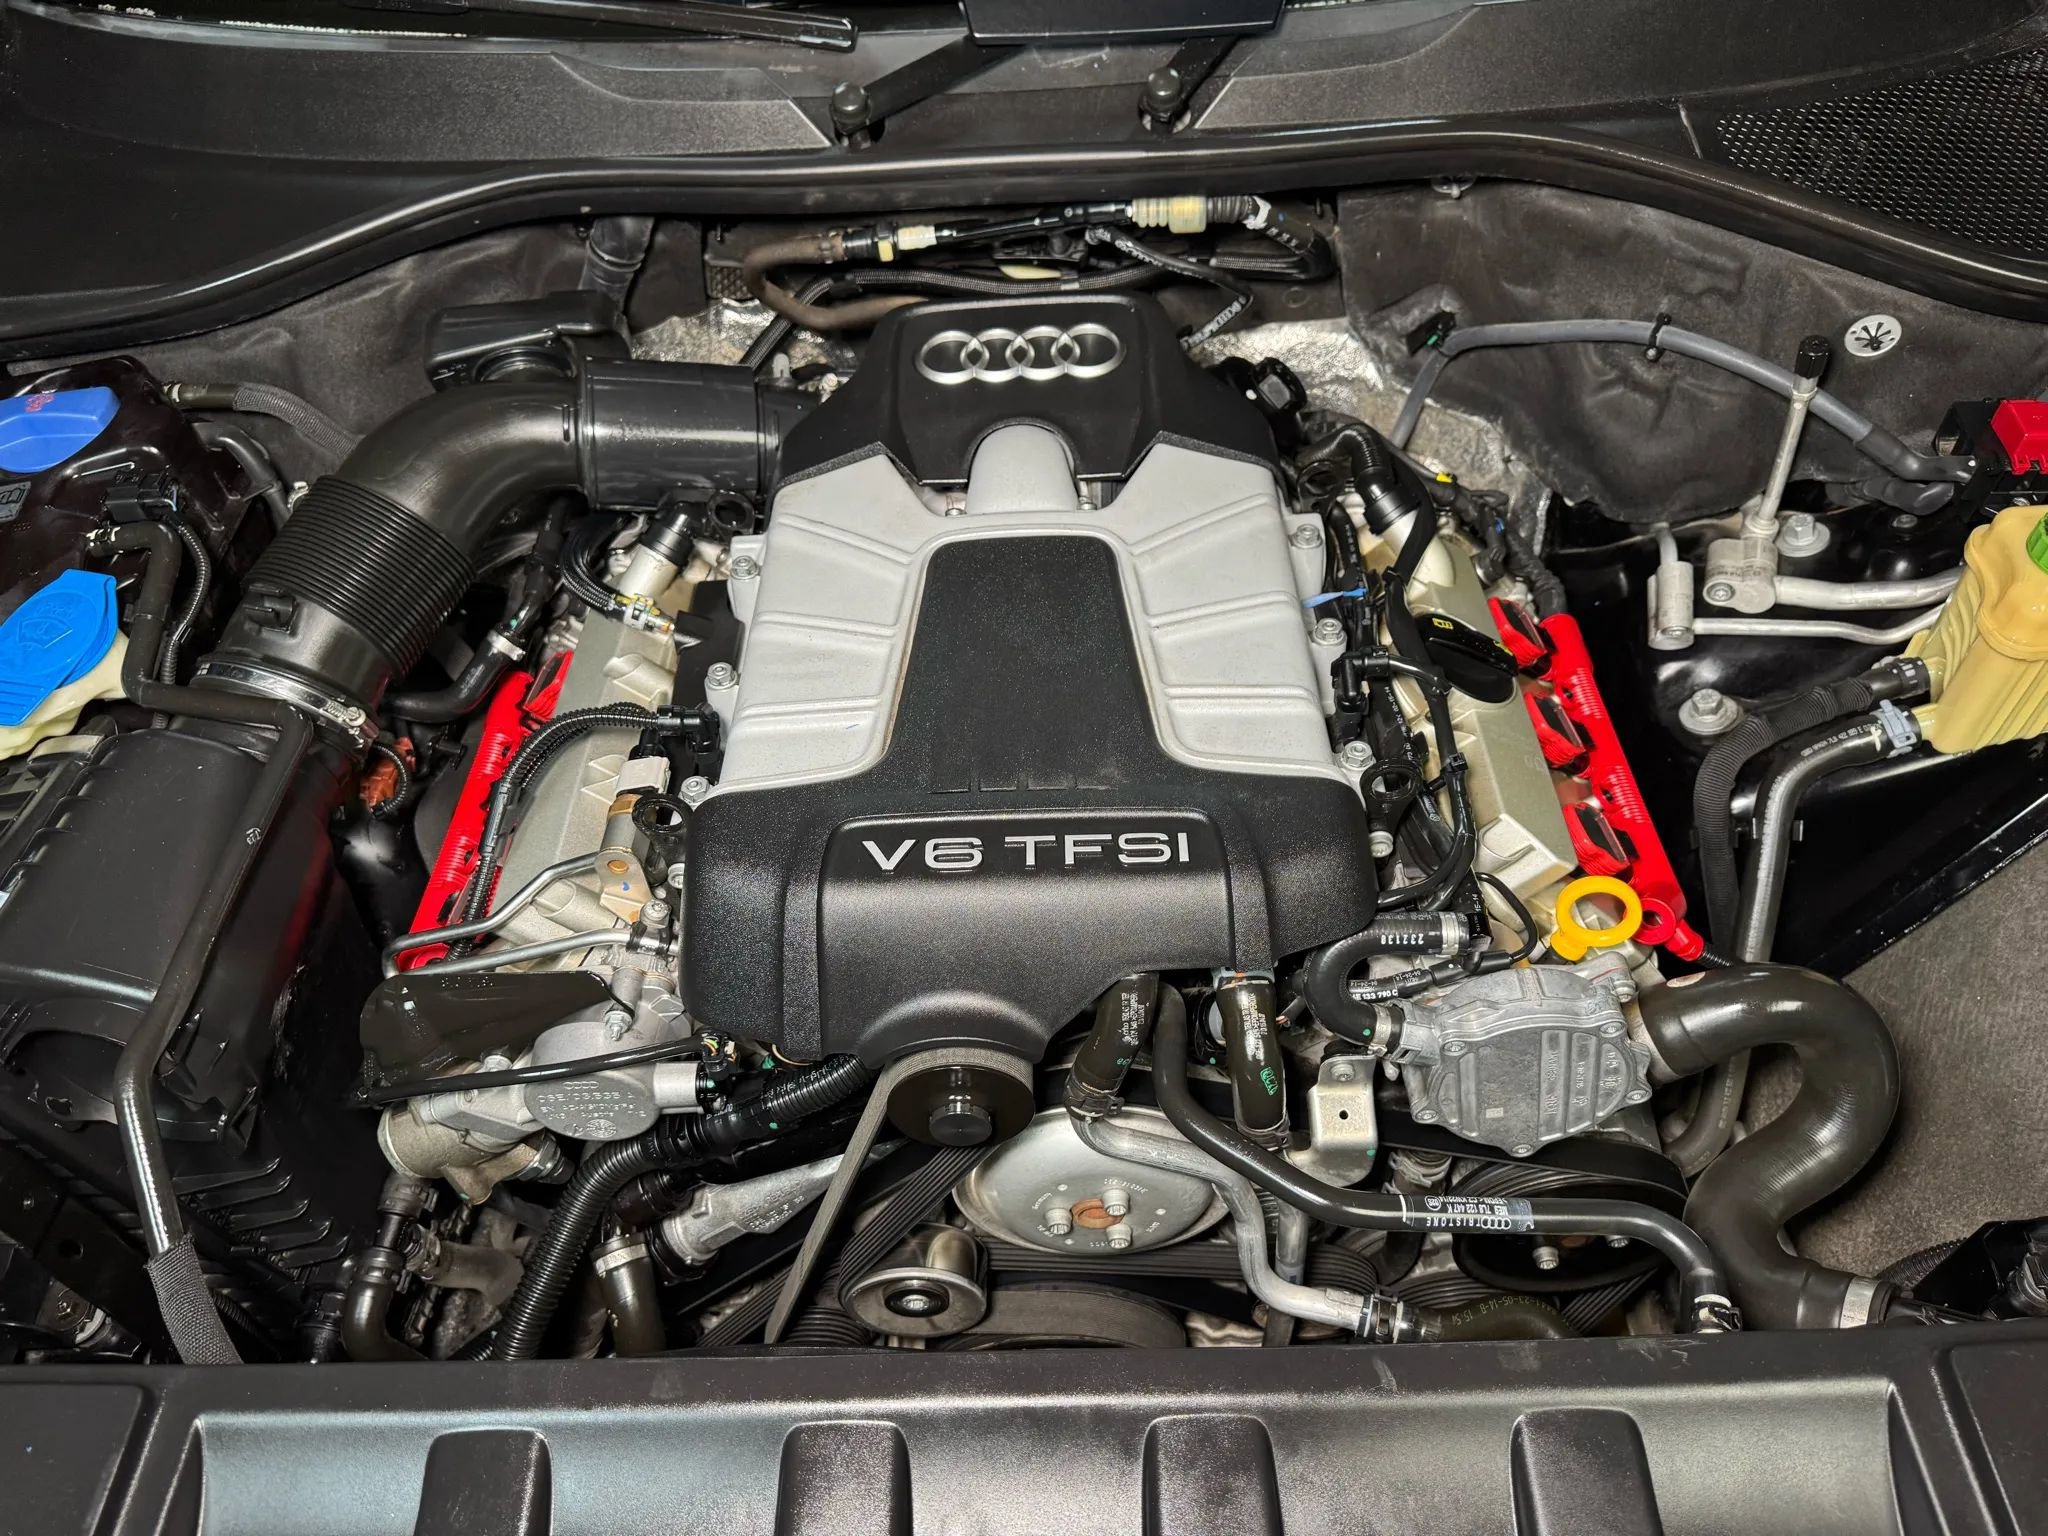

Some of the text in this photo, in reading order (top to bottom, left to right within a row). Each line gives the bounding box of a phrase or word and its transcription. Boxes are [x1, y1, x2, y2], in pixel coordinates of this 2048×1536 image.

[862, 831, 1191, 873] V6 TFSI
[1426, 1216, 1480, 1227] TRISTONE
